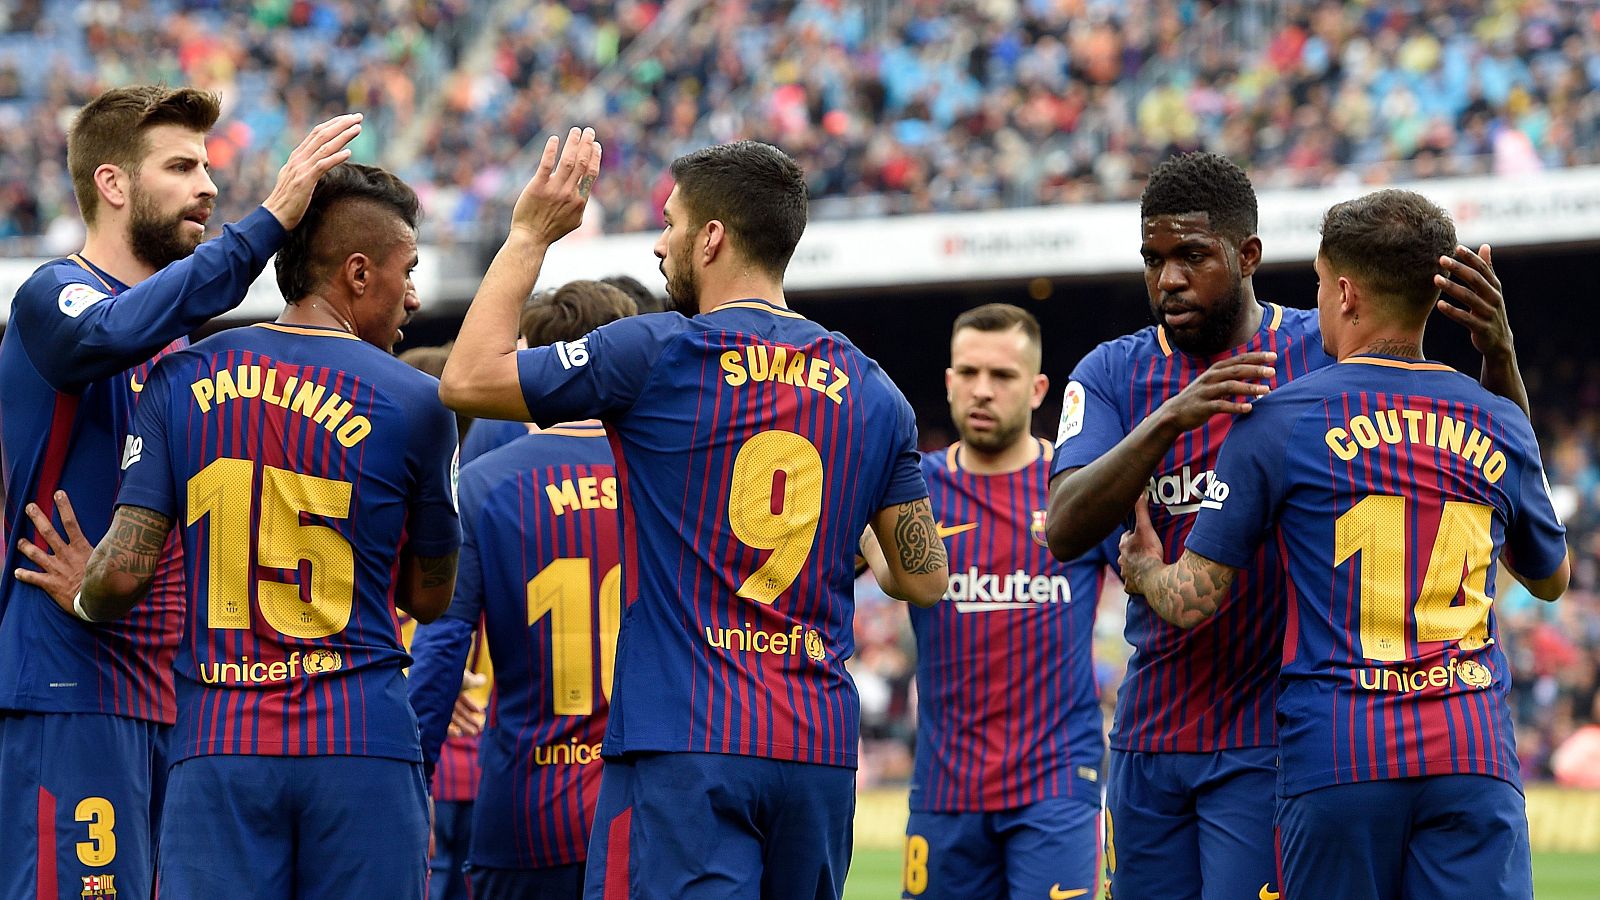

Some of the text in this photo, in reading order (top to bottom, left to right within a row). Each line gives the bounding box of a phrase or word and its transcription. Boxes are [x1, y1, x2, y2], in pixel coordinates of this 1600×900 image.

[720, 344, 850, 405] SUAREZ
[191, 364, 372, 448] PAULINHO
[1325, 409, 1507, 484] COUTINHO
[545, 476, 618, 516] MES
[729, 430, 824, 605] 9
[187, 457, 355, 638] 15
[1334, 495, 1494, 661] 14
[942, 566, 1072, 604] akuten
[200, 651, 300, 684] unicef
[706, 622, 803, 656] unicef
[1360, 658, 1457, 692] unicef
[535, 736, 603, 766] unice
[75, 797, 117, 867] 3
[904, 834, 929, 895] 8
